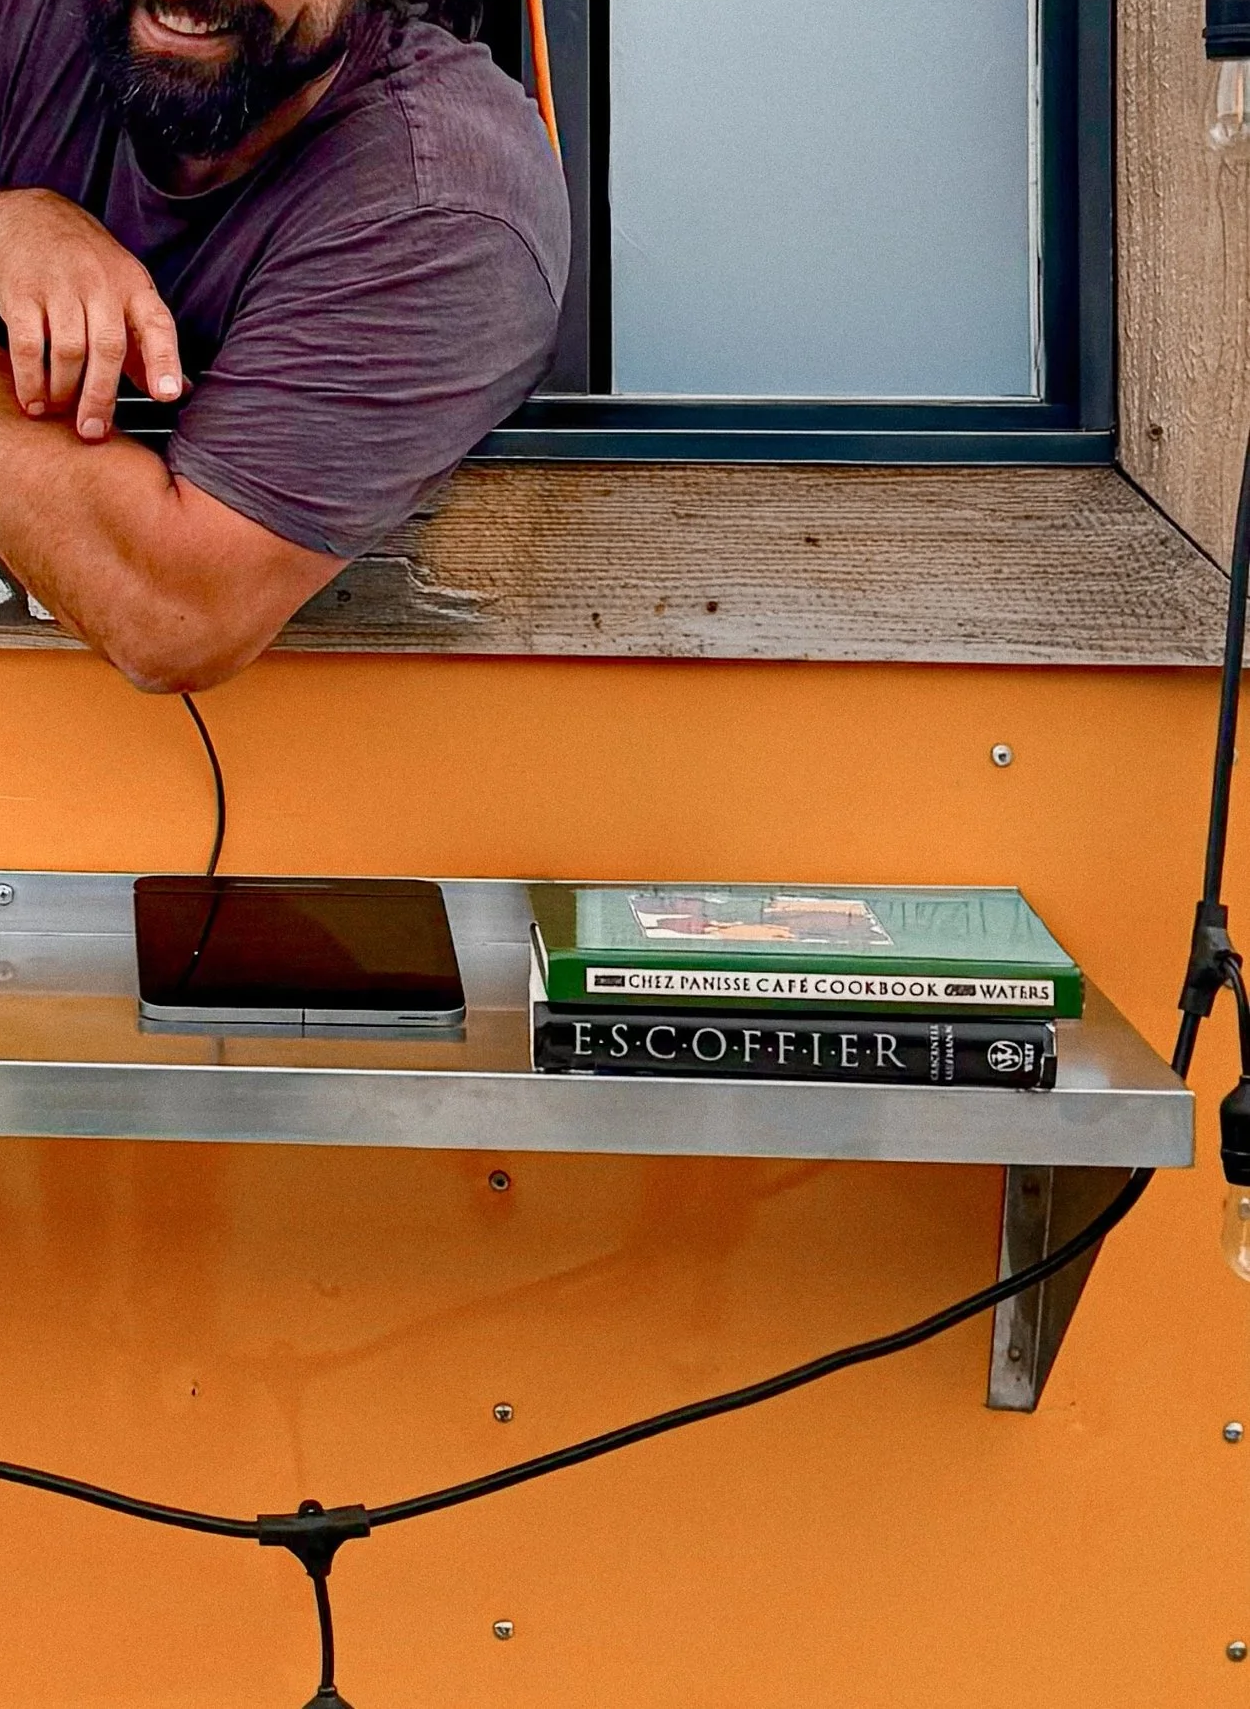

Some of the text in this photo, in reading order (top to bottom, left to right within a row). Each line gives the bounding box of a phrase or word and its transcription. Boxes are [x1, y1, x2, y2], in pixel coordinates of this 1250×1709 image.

[628, 973, 676, 990] CHEZ
[680, 975, 752, 992] PANISSE
[755, 976, 808, 994] CAFÉ
[814, 978, 940, 997] COOKBOOK
[979, 984, 1049, 1001] WATERS
